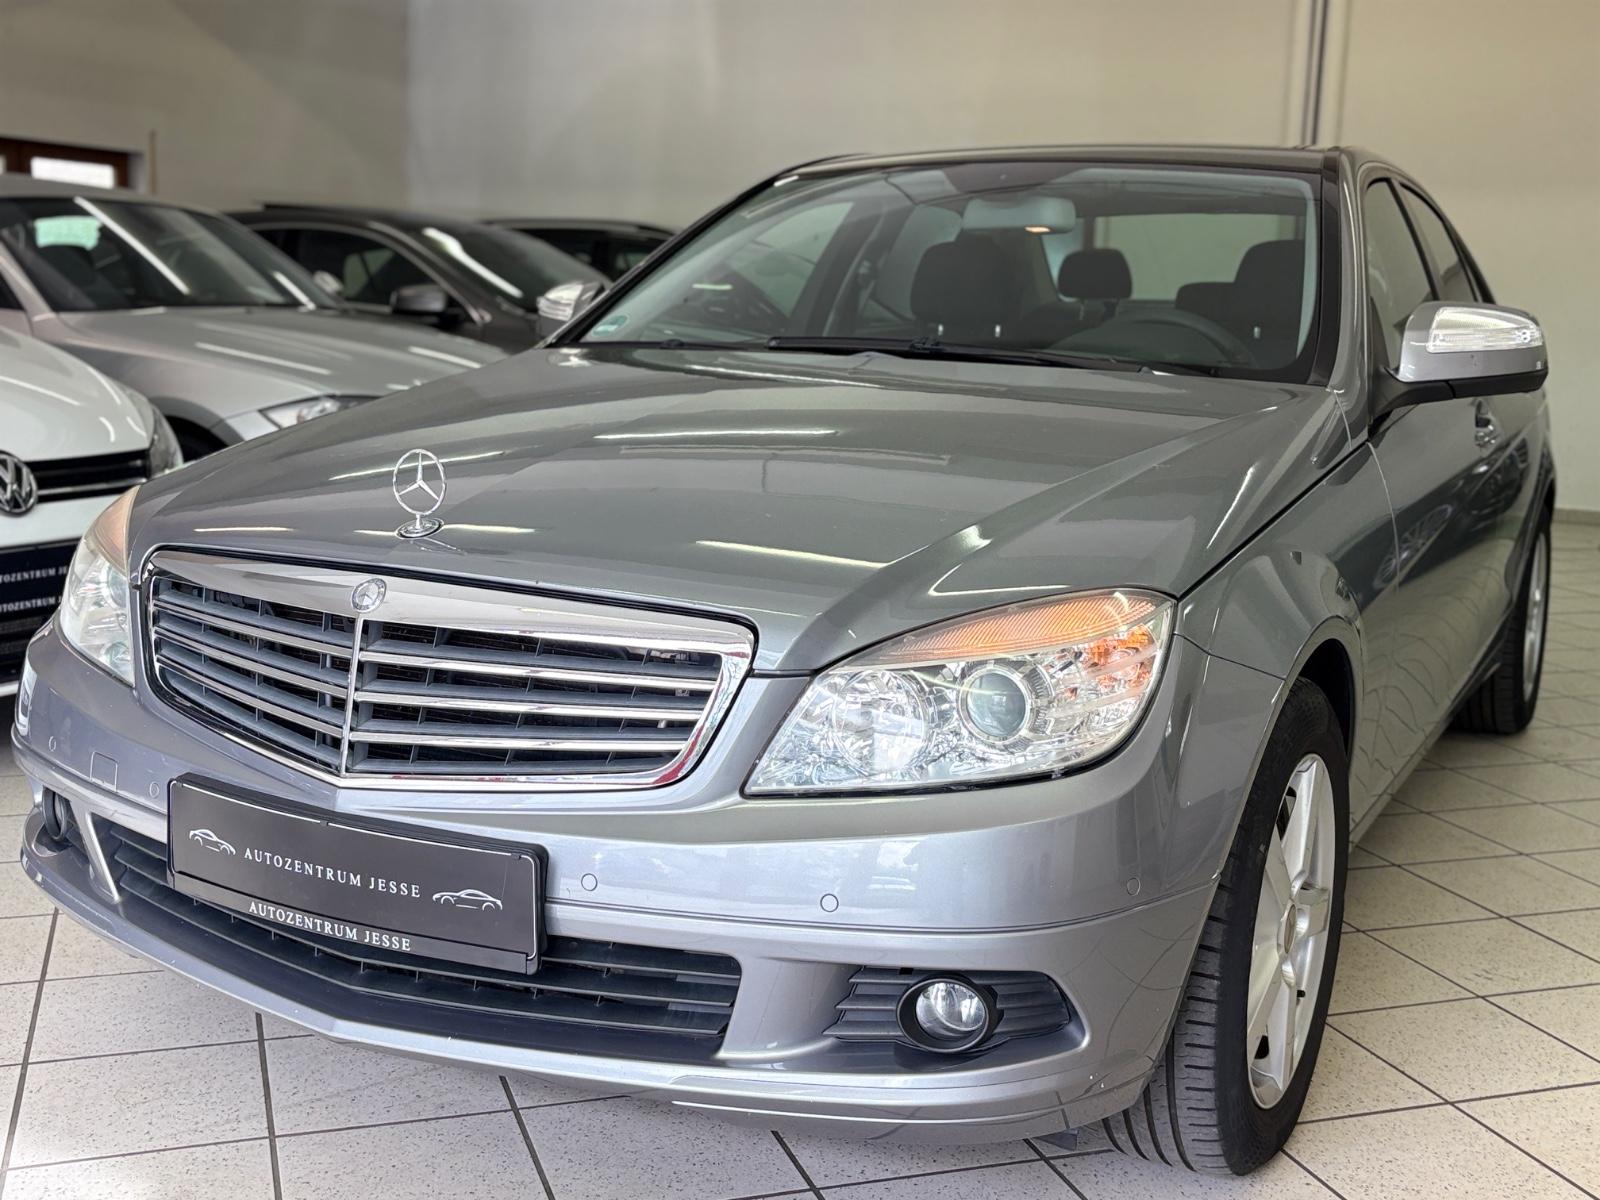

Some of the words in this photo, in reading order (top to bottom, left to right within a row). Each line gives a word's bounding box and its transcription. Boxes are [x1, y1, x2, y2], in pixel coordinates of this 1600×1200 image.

[244, 847, 361, 887] AUTOZENTRUM
[369, 877, 421, 898] JESSE
[249, 901, 358, 941] AUTOZENTRUM
[364, 930, 411, 951] JESSE
